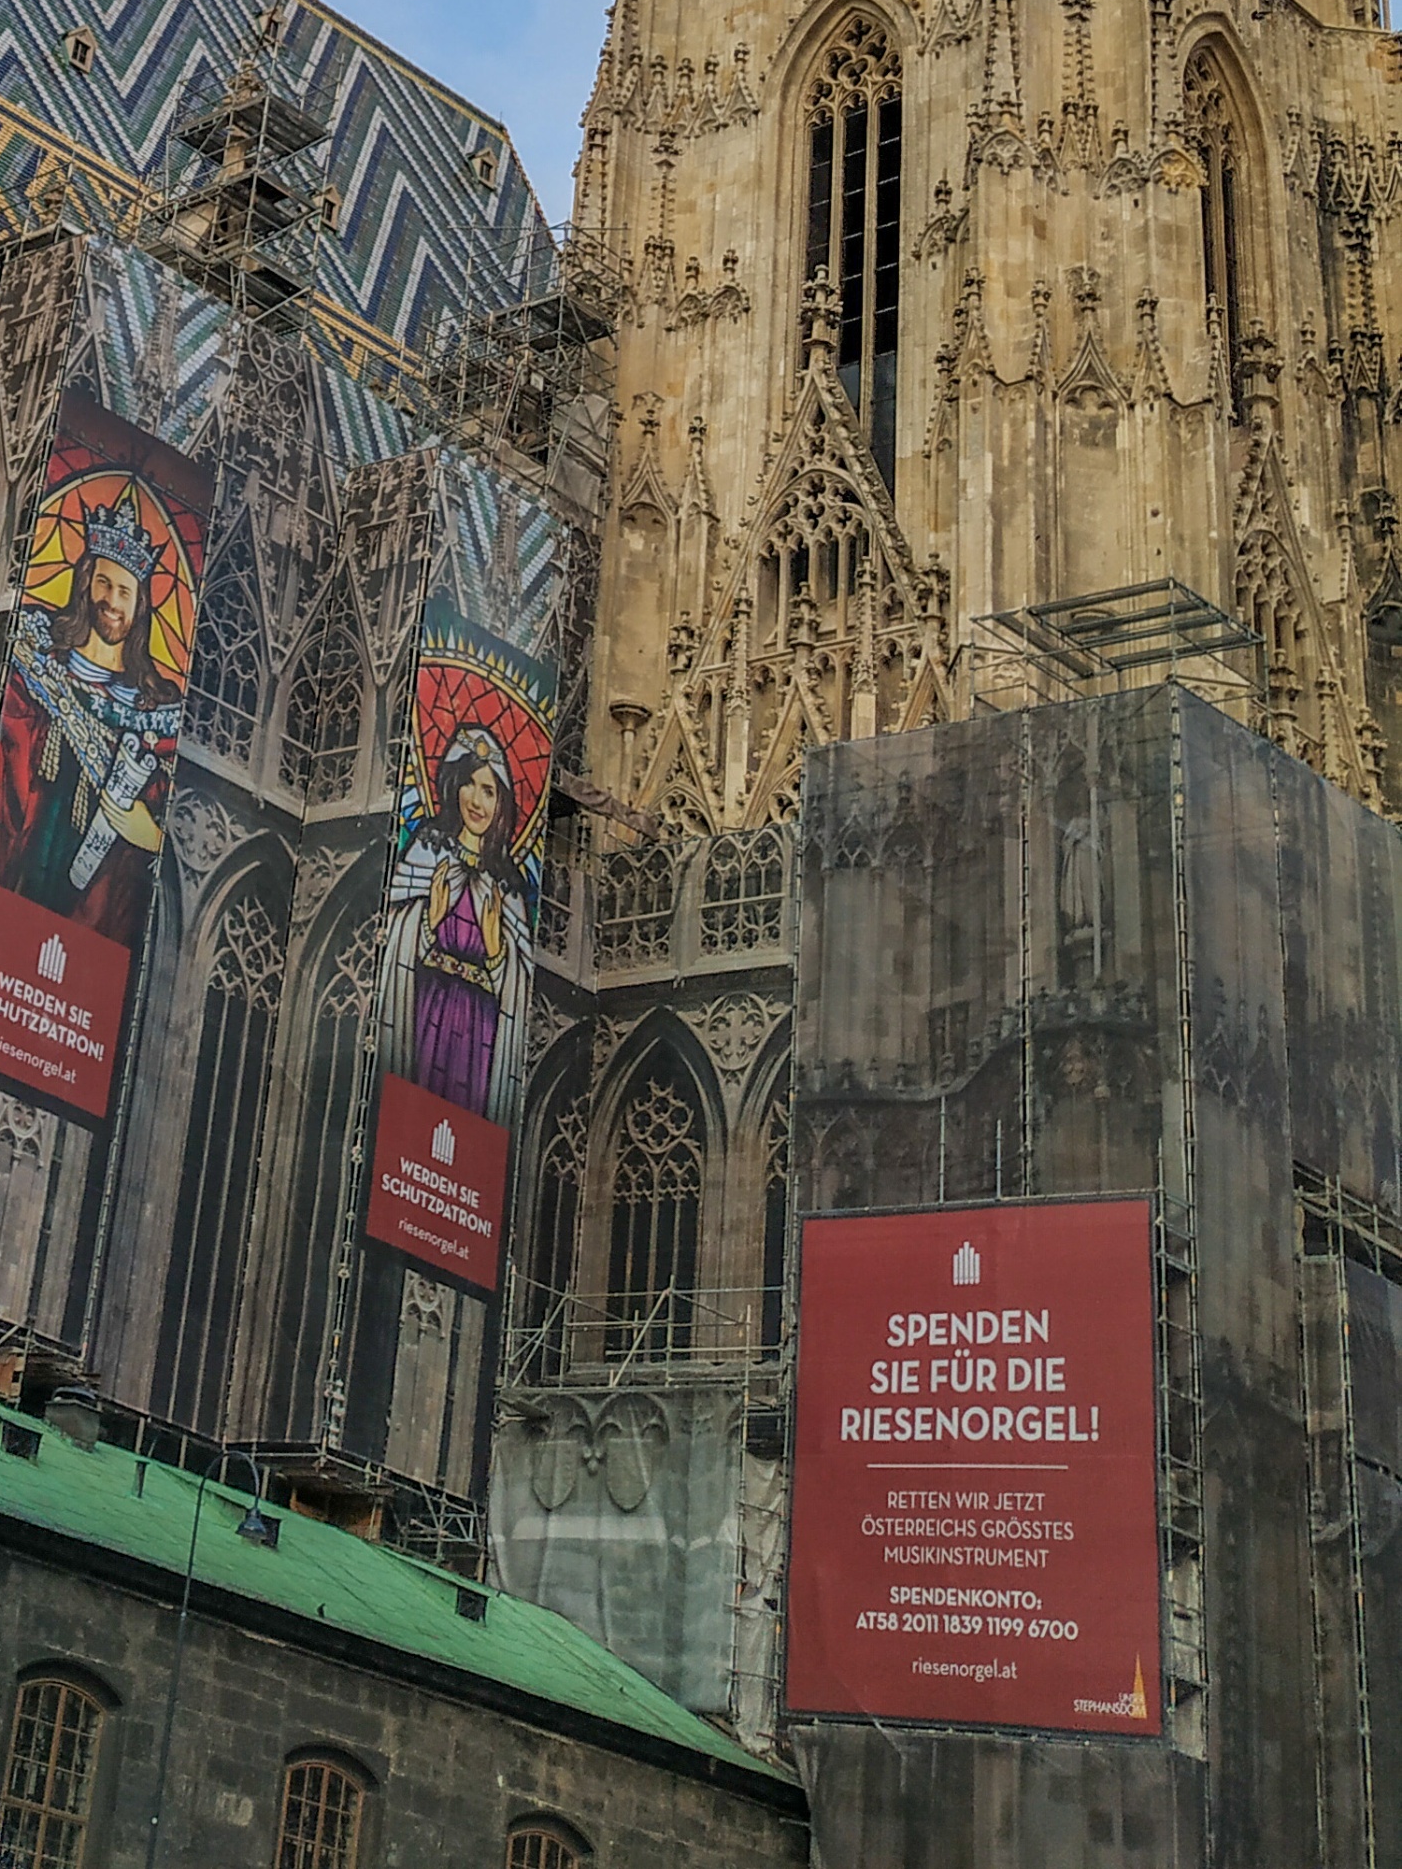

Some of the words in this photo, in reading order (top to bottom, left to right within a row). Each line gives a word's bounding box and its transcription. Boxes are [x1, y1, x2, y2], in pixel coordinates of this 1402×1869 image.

[0, 971, 67, 1018] WERDEN
[68, 1005, 93, 1031] SIE
[400, 1156, 458, 1198] WERDEN
[459, 1186, 480, 1209] SIE
[381, 1173, 492, 1238] SCHUTZPATRON!
[398, 1217, 470, 1261] riesenorgel.at
[887, 1310, 1049, 1347] SPENDEN
[870, 1360, 920, 1394] SIE
[930, 1348, 997, 1393] FÜR
[1007, 1357, 1066, 1392] DIE
[840, 1406, 1099, 1442] RIESENORGEL!
[887, 1491, 951, 1509] RETTEN
[955, 1492, 989, 1510] WIR
[993, 1492, 1045, 1511] JETZT
[861, 1514, 977, 1537] ÖSTERREICHS
[980, 1515, 1074, 1541] GRÖSSTES
[884, 1546, 1049, 1568] MUSIKINSTRUMENT
[889, 1586, 1042, 1610] SPENDENKONTO:
[855, 1612, 898, 1631] AT58
[902, 1613, 939, 1633] 2011
[942, 1614, 983, 1635] 1839
[986, 1616, 1025, 1637] 1199
[1028, 1619, 1079, 1641] 6700
[912, 1658, 1017, 1682] riesenorgel.at
